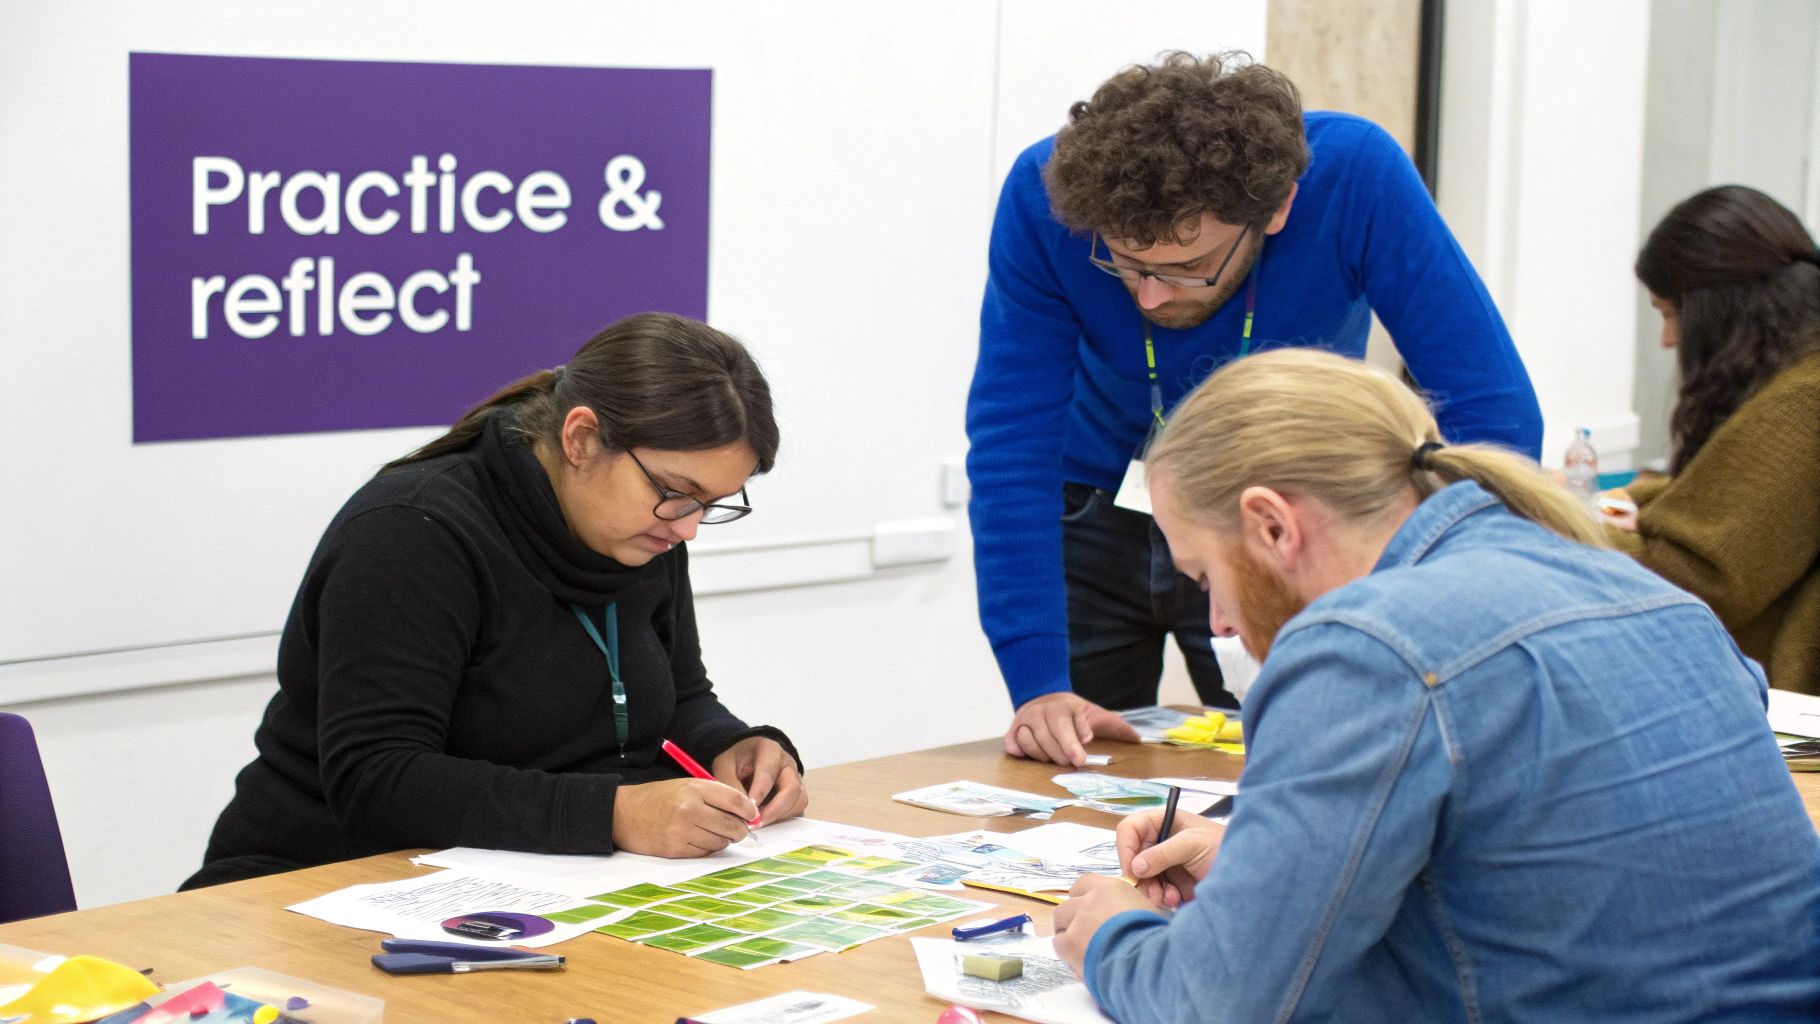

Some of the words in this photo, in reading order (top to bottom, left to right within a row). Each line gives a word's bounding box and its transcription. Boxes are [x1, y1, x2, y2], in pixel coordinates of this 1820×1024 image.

[191, 153, 573, 236] Practice
[598, 153, 665, 232] &
[191, 252, 482, 340] reflect
